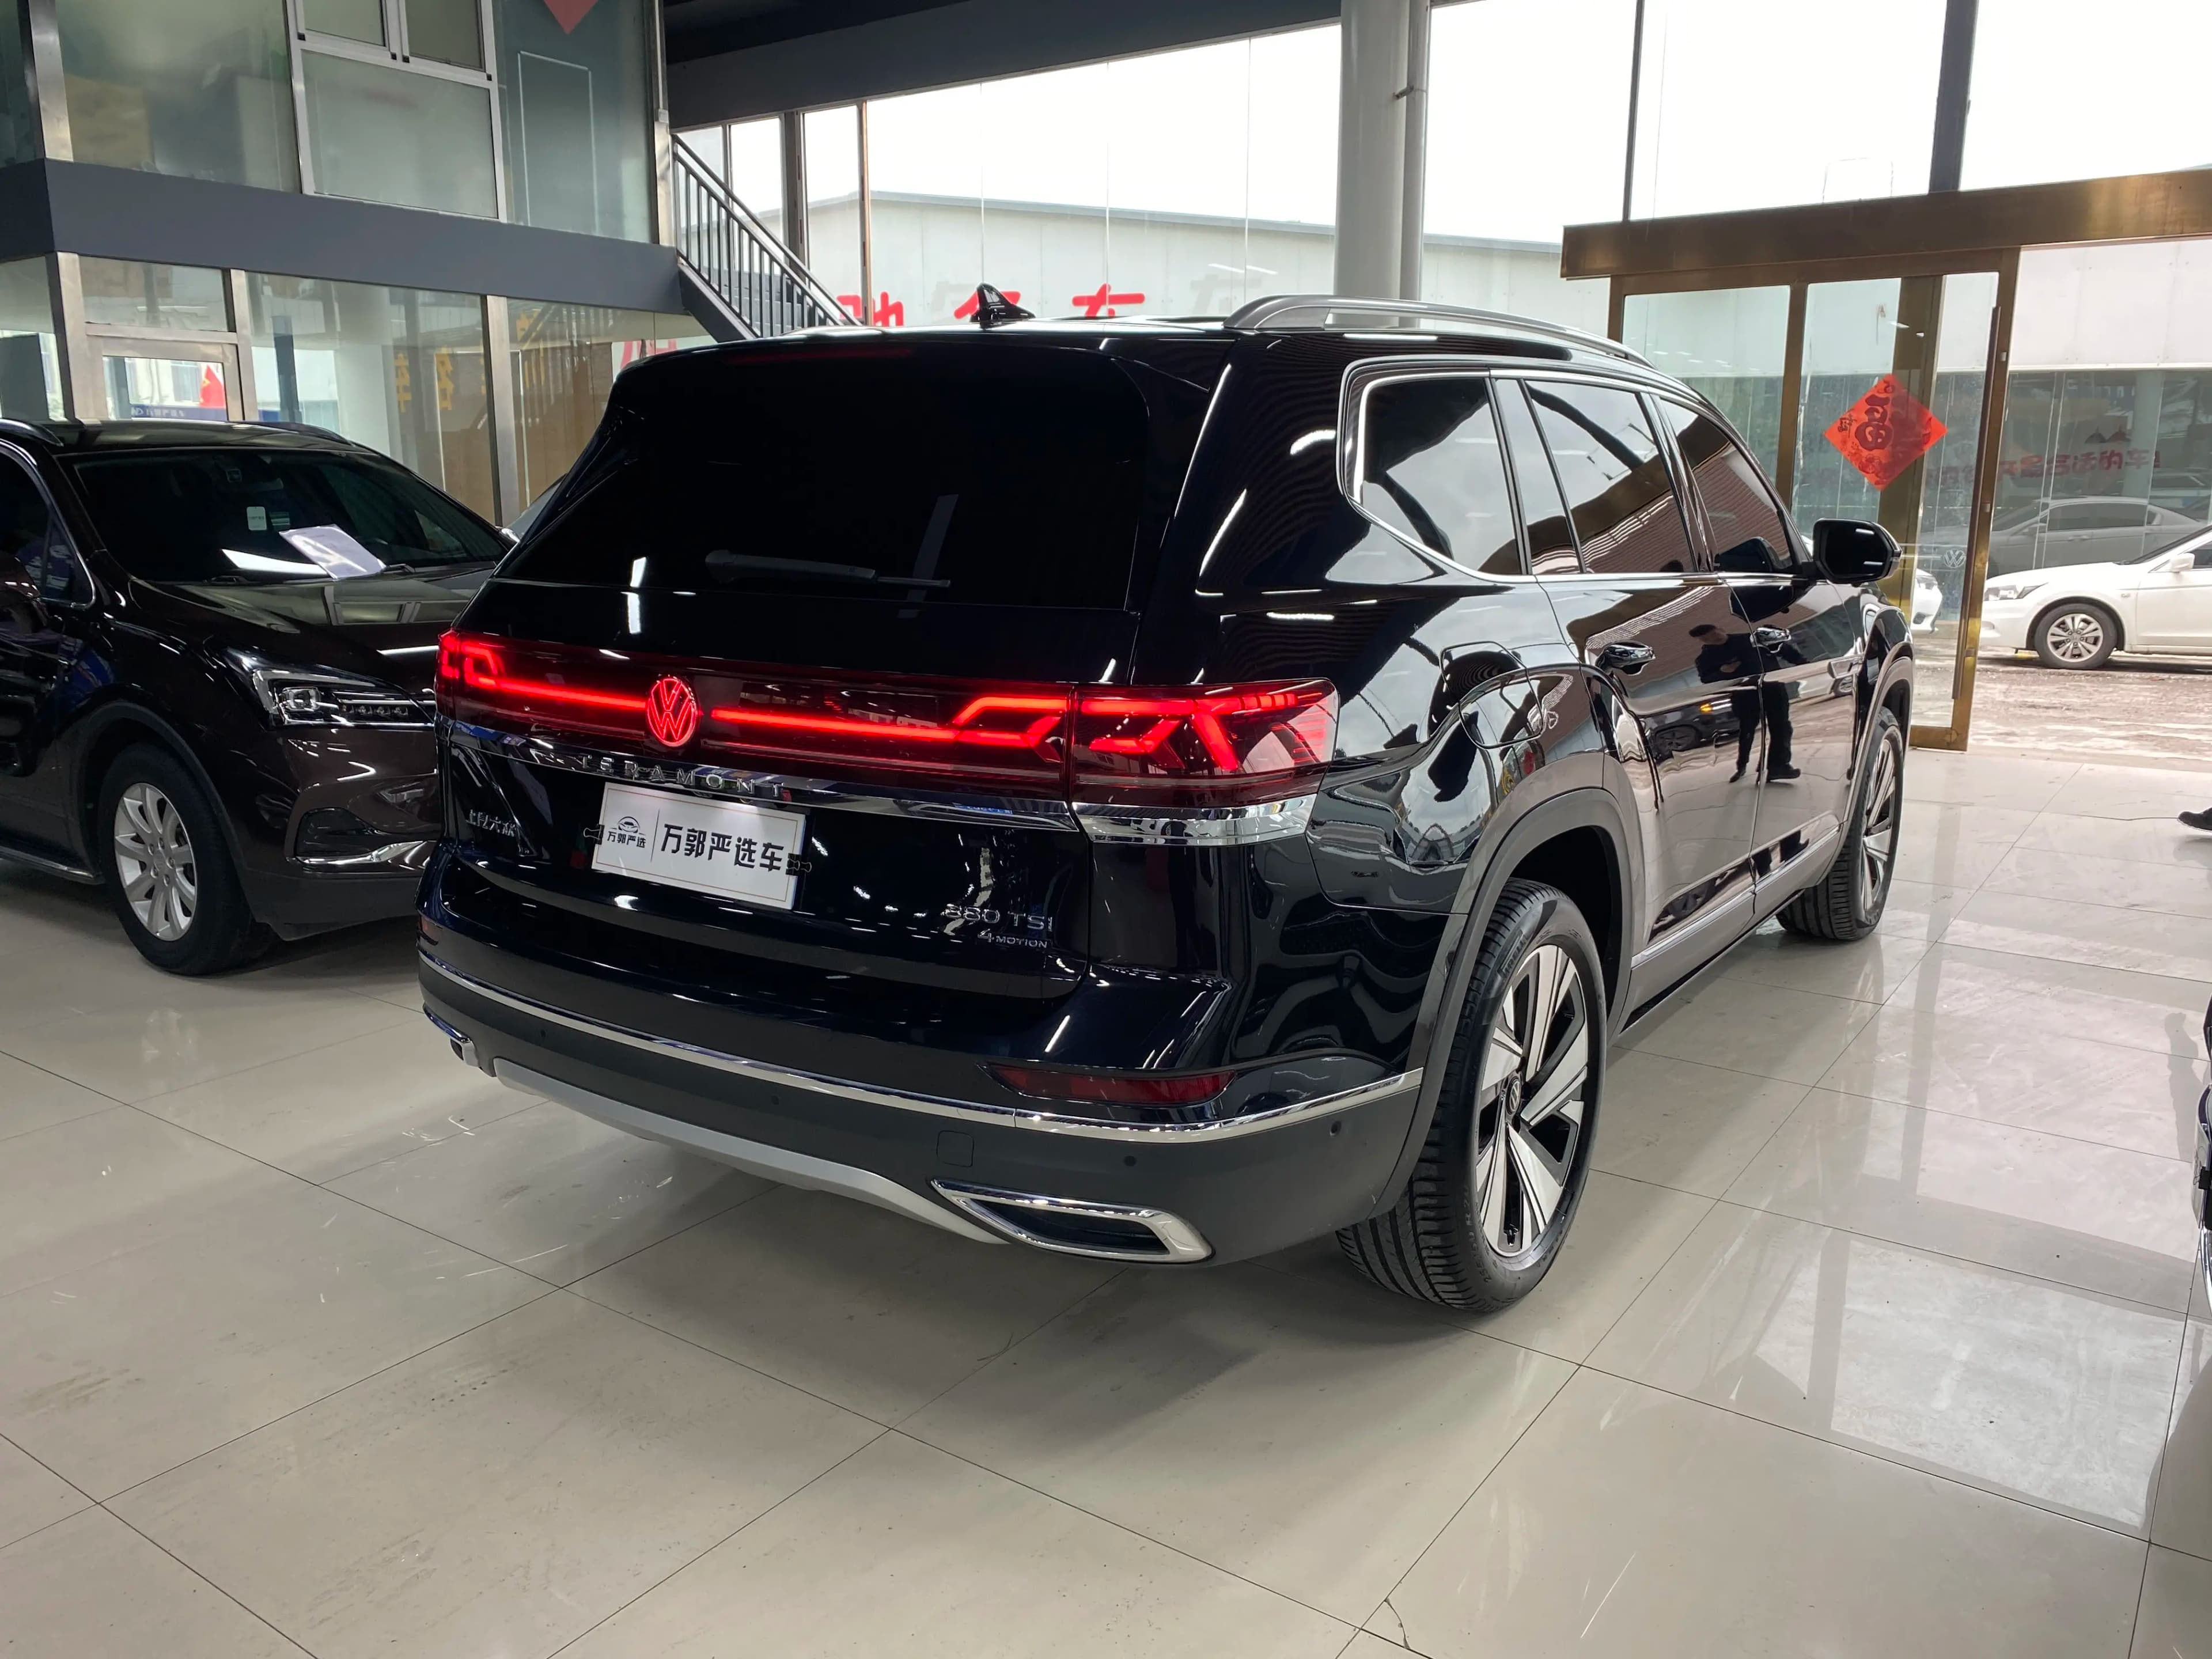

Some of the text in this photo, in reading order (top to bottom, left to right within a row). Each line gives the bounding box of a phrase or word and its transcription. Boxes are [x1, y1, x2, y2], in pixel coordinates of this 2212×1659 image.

[578, 754, 785, 797] TERAMONT
[607, 831, 646, 849] 万郭严选
[661, 823, 785, 872] 万郭严选车
[1007, 911, 1053, 932] TSI
[978, 928, 1048, 948] 4MOTION
